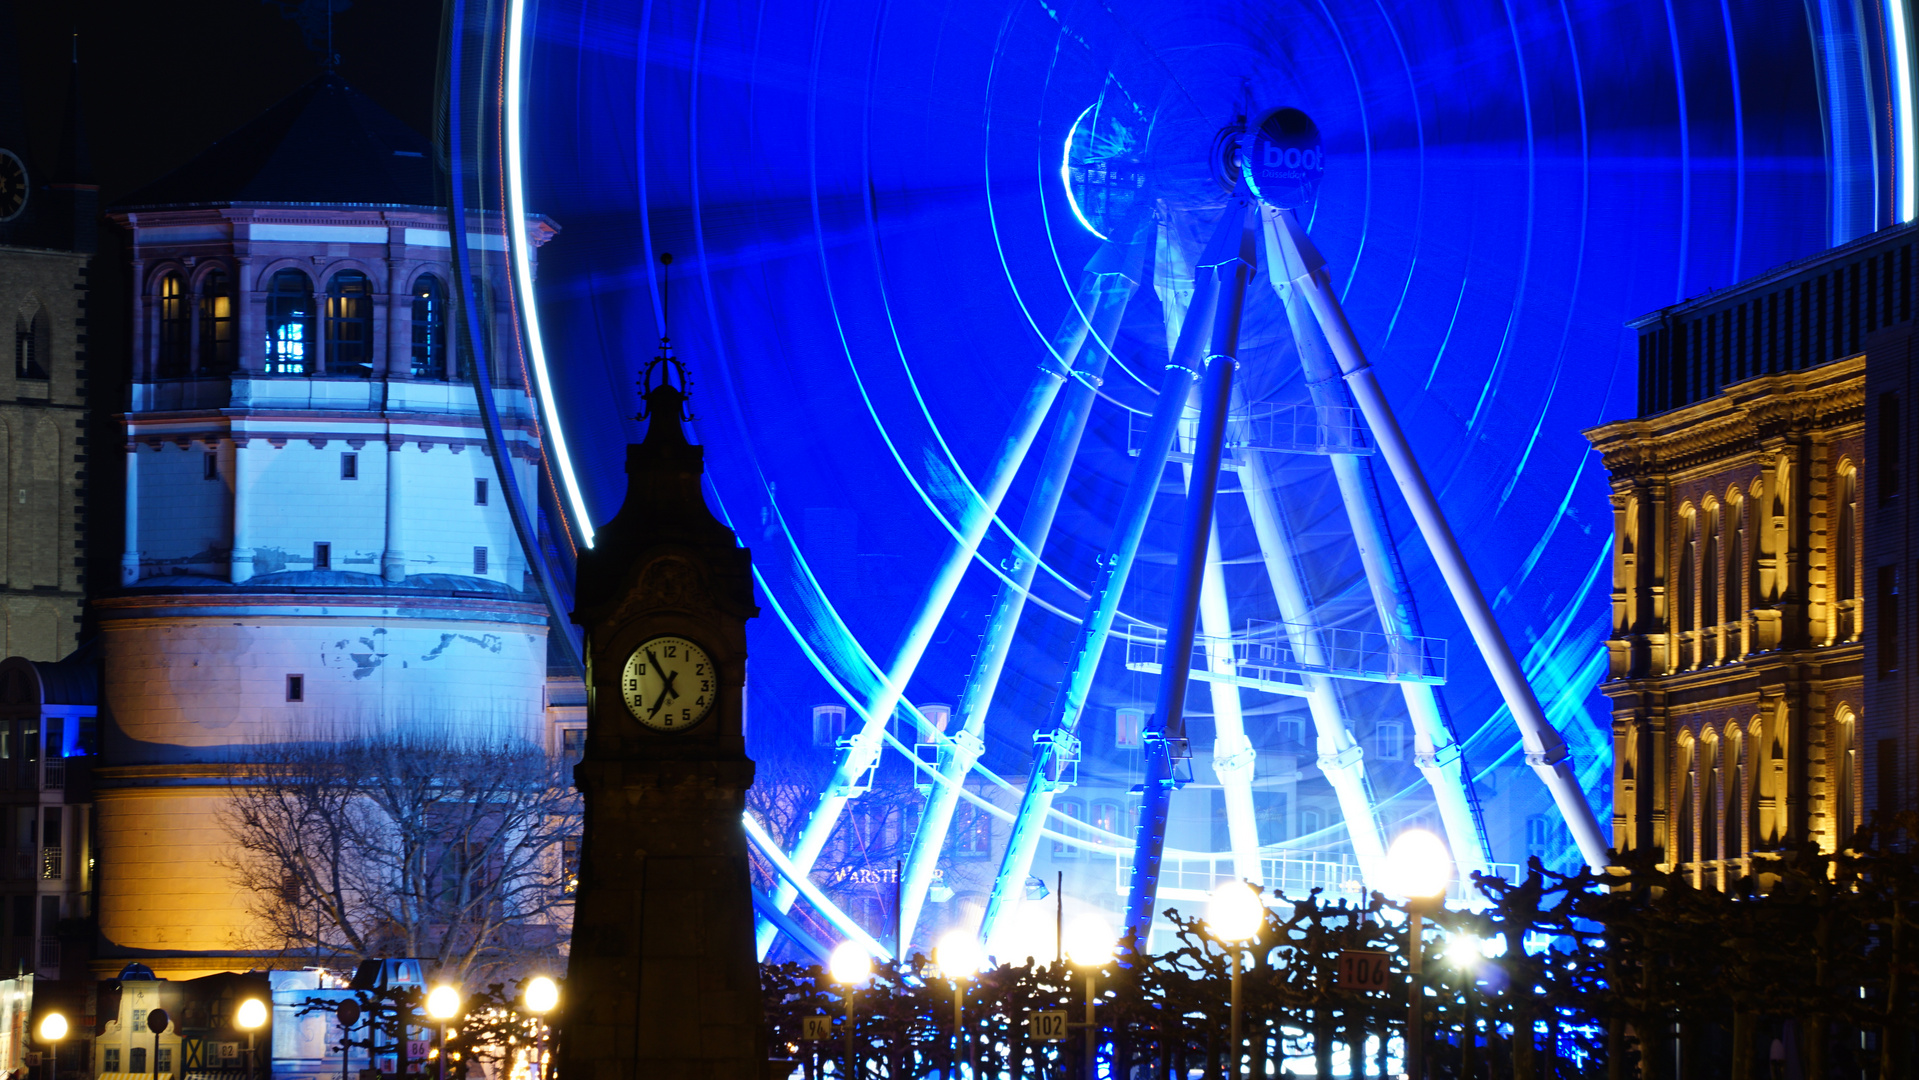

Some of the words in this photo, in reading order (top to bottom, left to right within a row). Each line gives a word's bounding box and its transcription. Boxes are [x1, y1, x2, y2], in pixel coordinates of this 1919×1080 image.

[1263, 141, 1323, 172] boot
[664, 646, 676, 658] 12
[635, 664, 646, 675] 10
[696, 664, 704, 676] 2
[630, 679, 637, 691] 9
[701, 681, 709, 692] 3
[634, 695, 642, 707] 8
[696, 696, 705, 707] 4
[665, 714, 673, 726] 6
[682, 709, 690, 720] 5
[1345, 958, 1384, 985] 106
[1034, 1015, 1062, 1036] 102
[222, 1045, 233, 1056] 82
[412, 1043, 425, 1055] 86
